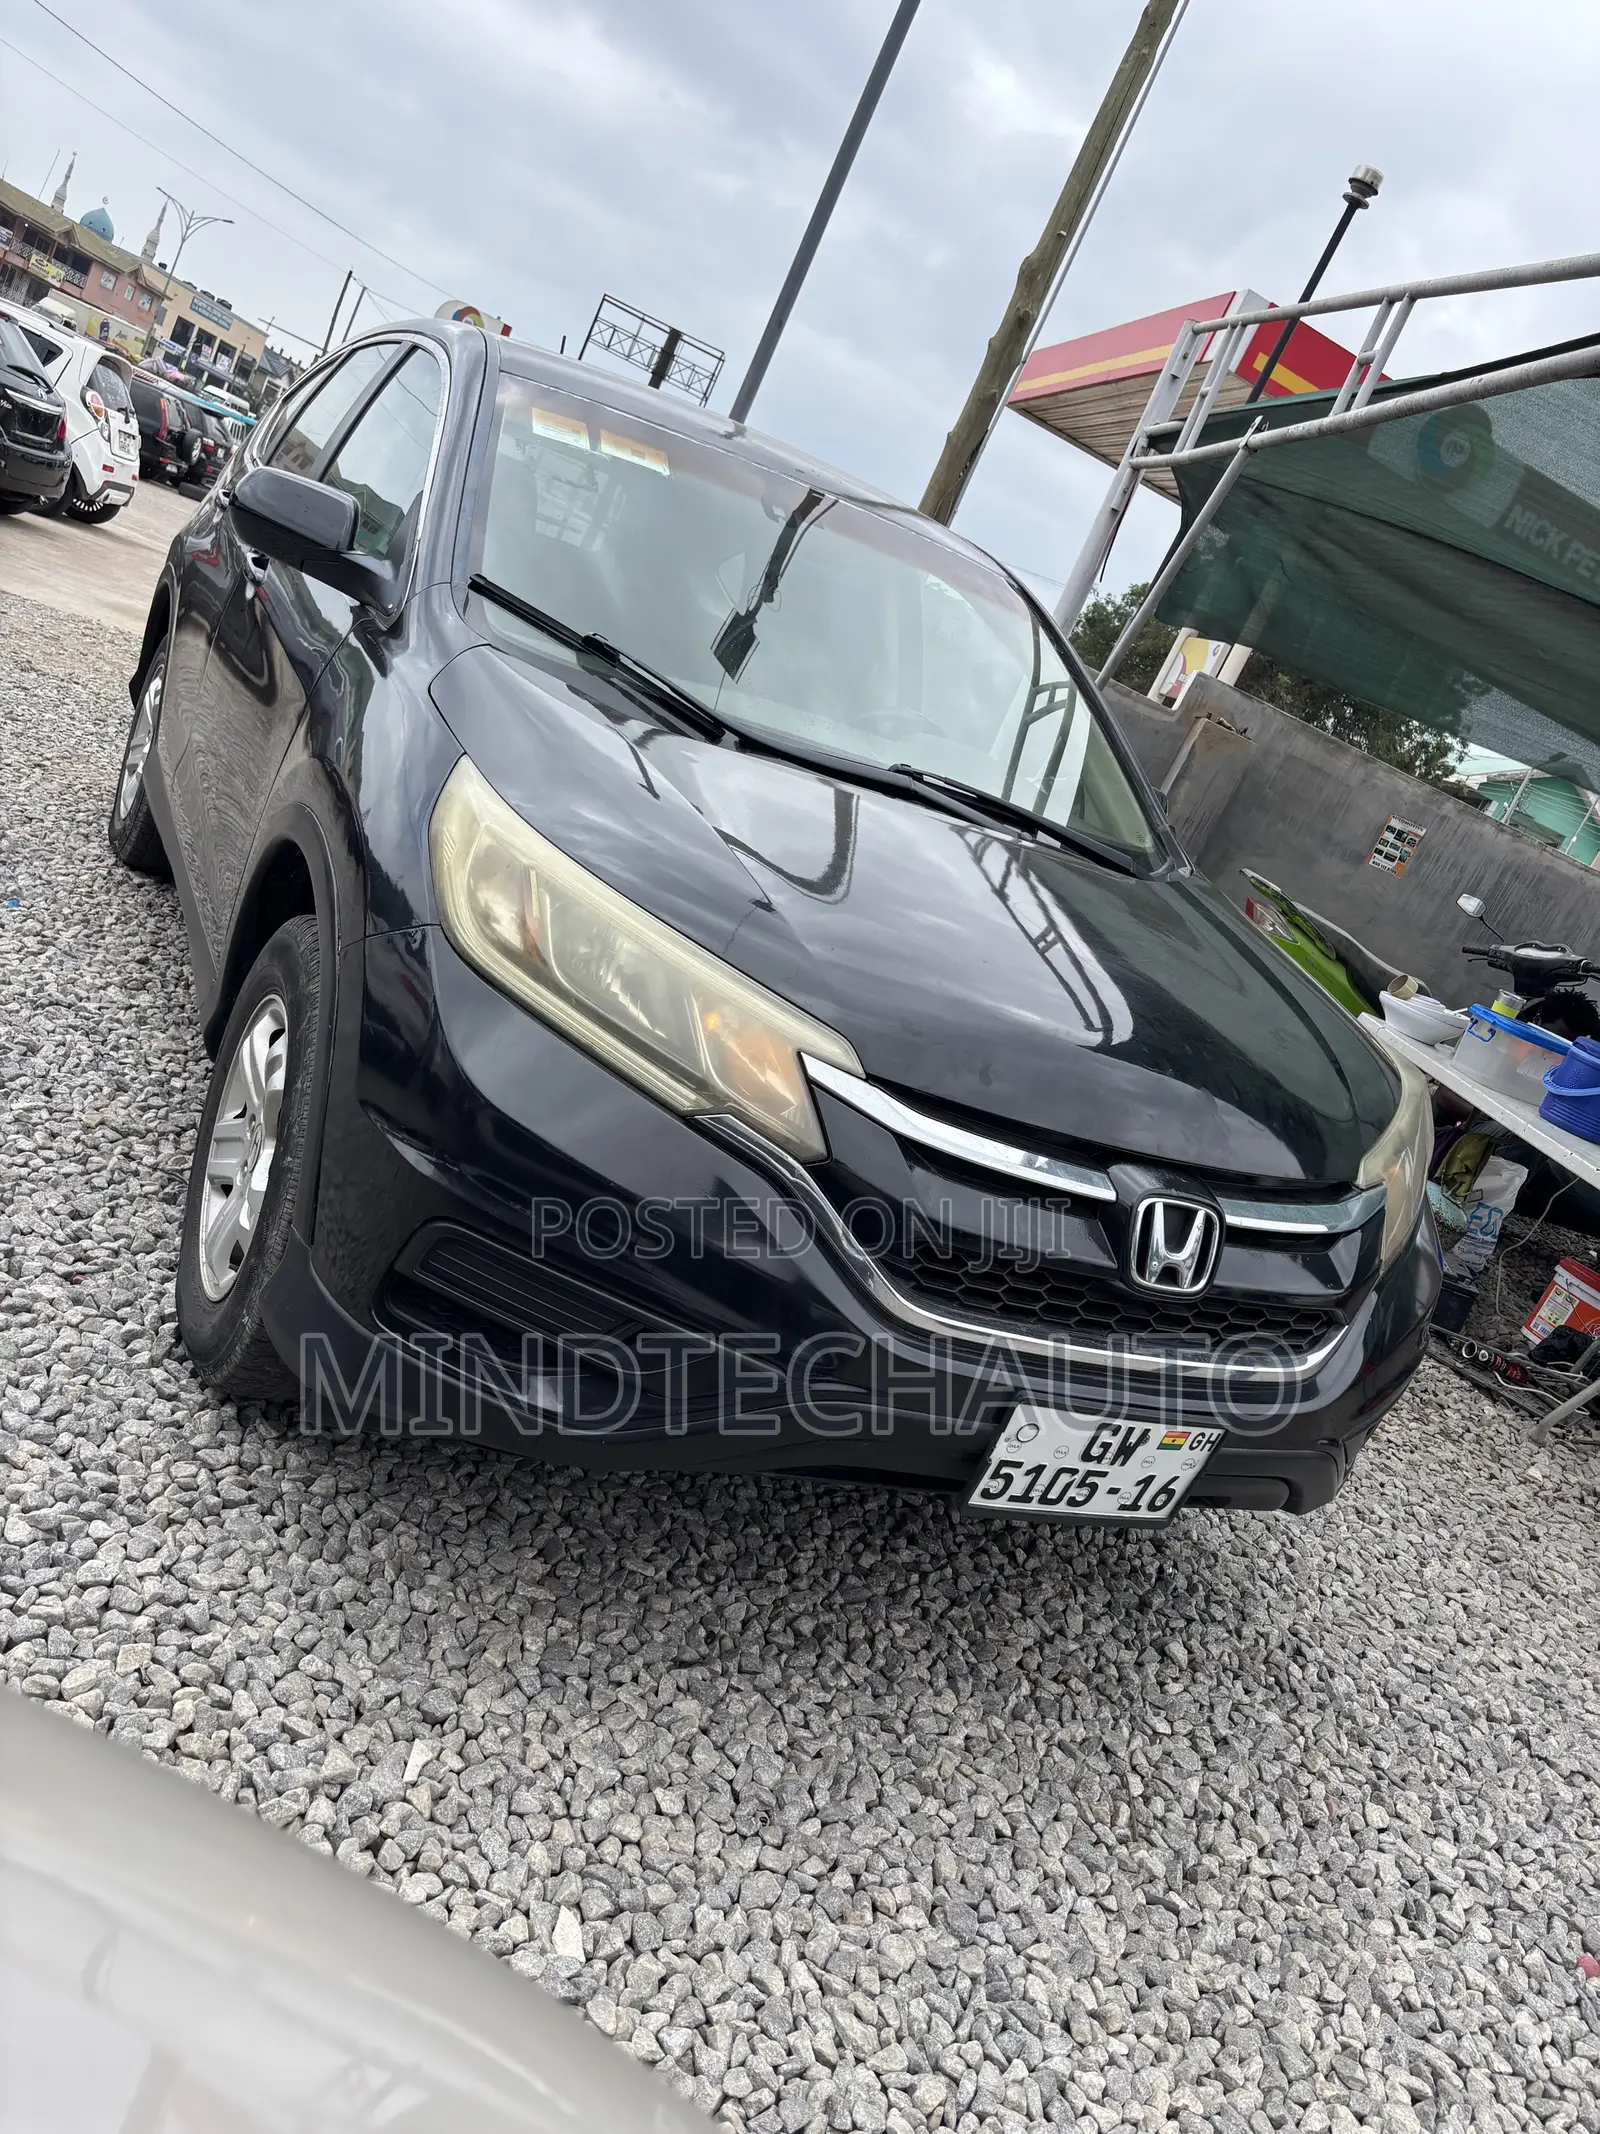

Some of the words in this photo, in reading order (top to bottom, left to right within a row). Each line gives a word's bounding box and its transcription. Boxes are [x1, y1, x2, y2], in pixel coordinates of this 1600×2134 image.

[1504, 503, 1570, 560] NICK
[1080, 1422, 1152, 1467] GW
[1189, 1431, 1222, 1452] GH
[980, 1459, 1180, 1512] 5105-16
